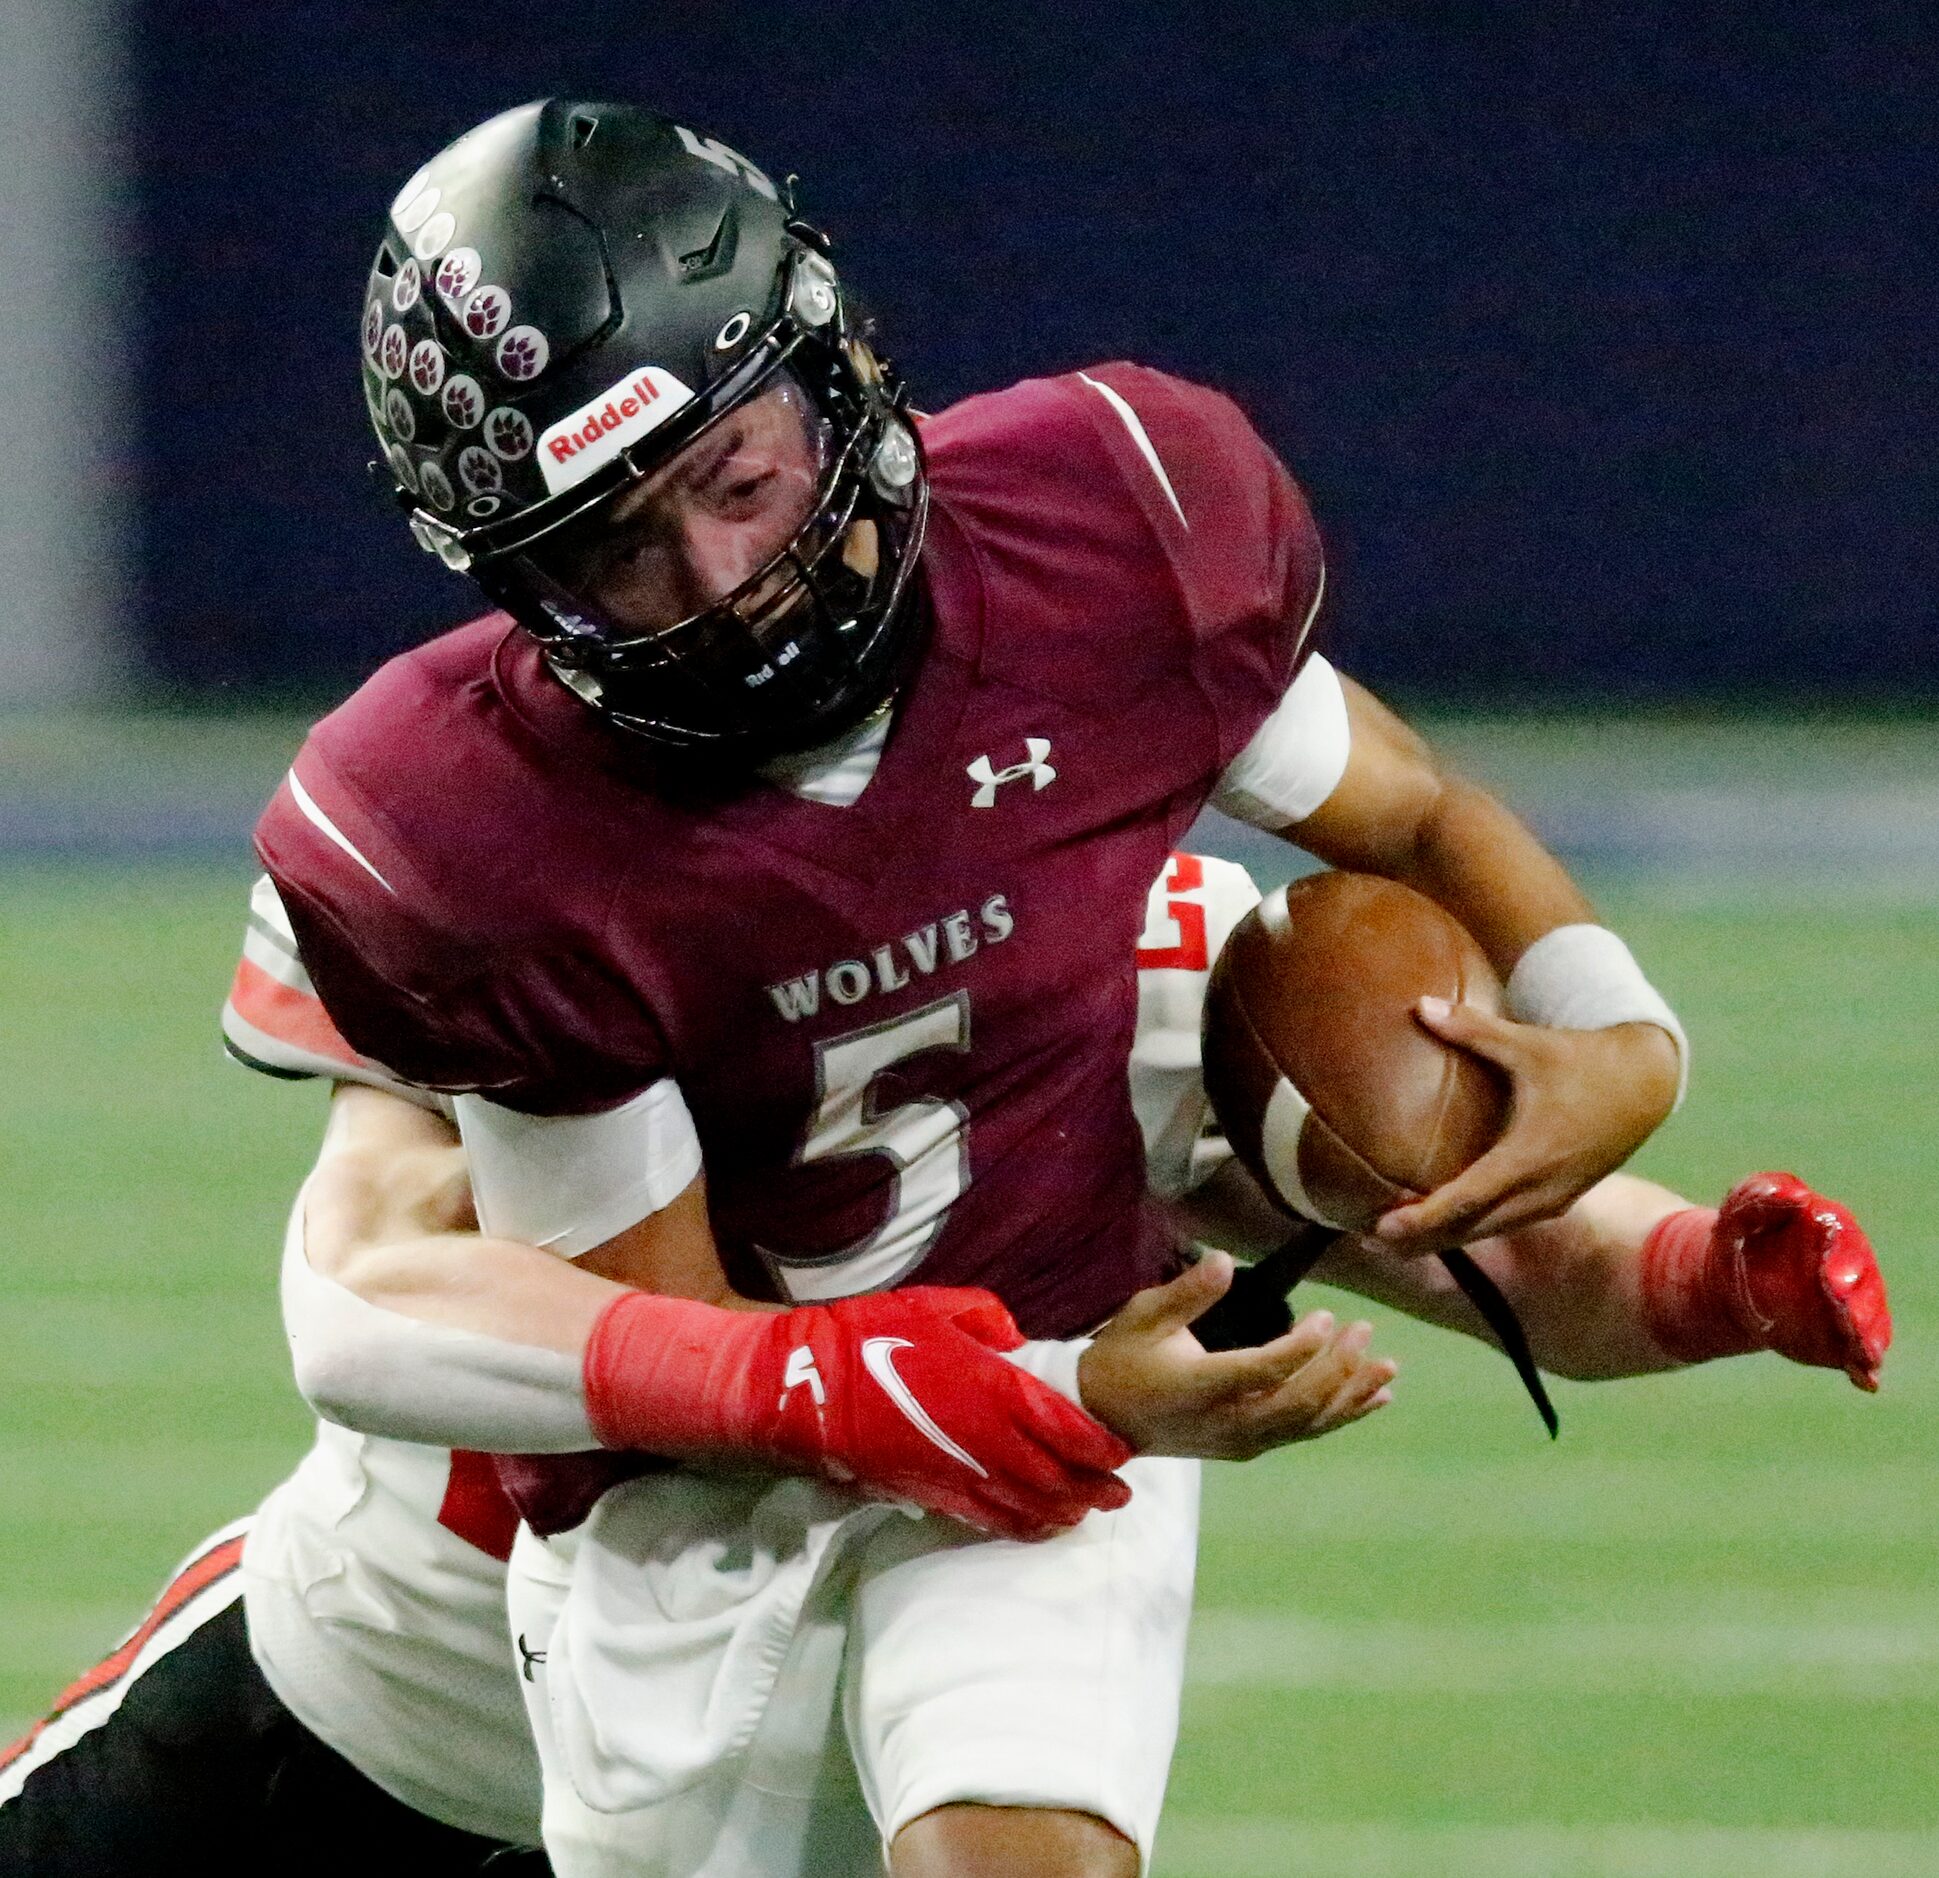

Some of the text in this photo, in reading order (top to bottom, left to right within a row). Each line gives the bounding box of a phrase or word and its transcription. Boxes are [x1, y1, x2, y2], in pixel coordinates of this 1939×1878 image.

[548, 376, 660, 464] Riddell
[743, 641, 800, 688] Ridell
[763, 894, 1015, 1024] WOLVES
[752, 987, 972, 1308] 5
